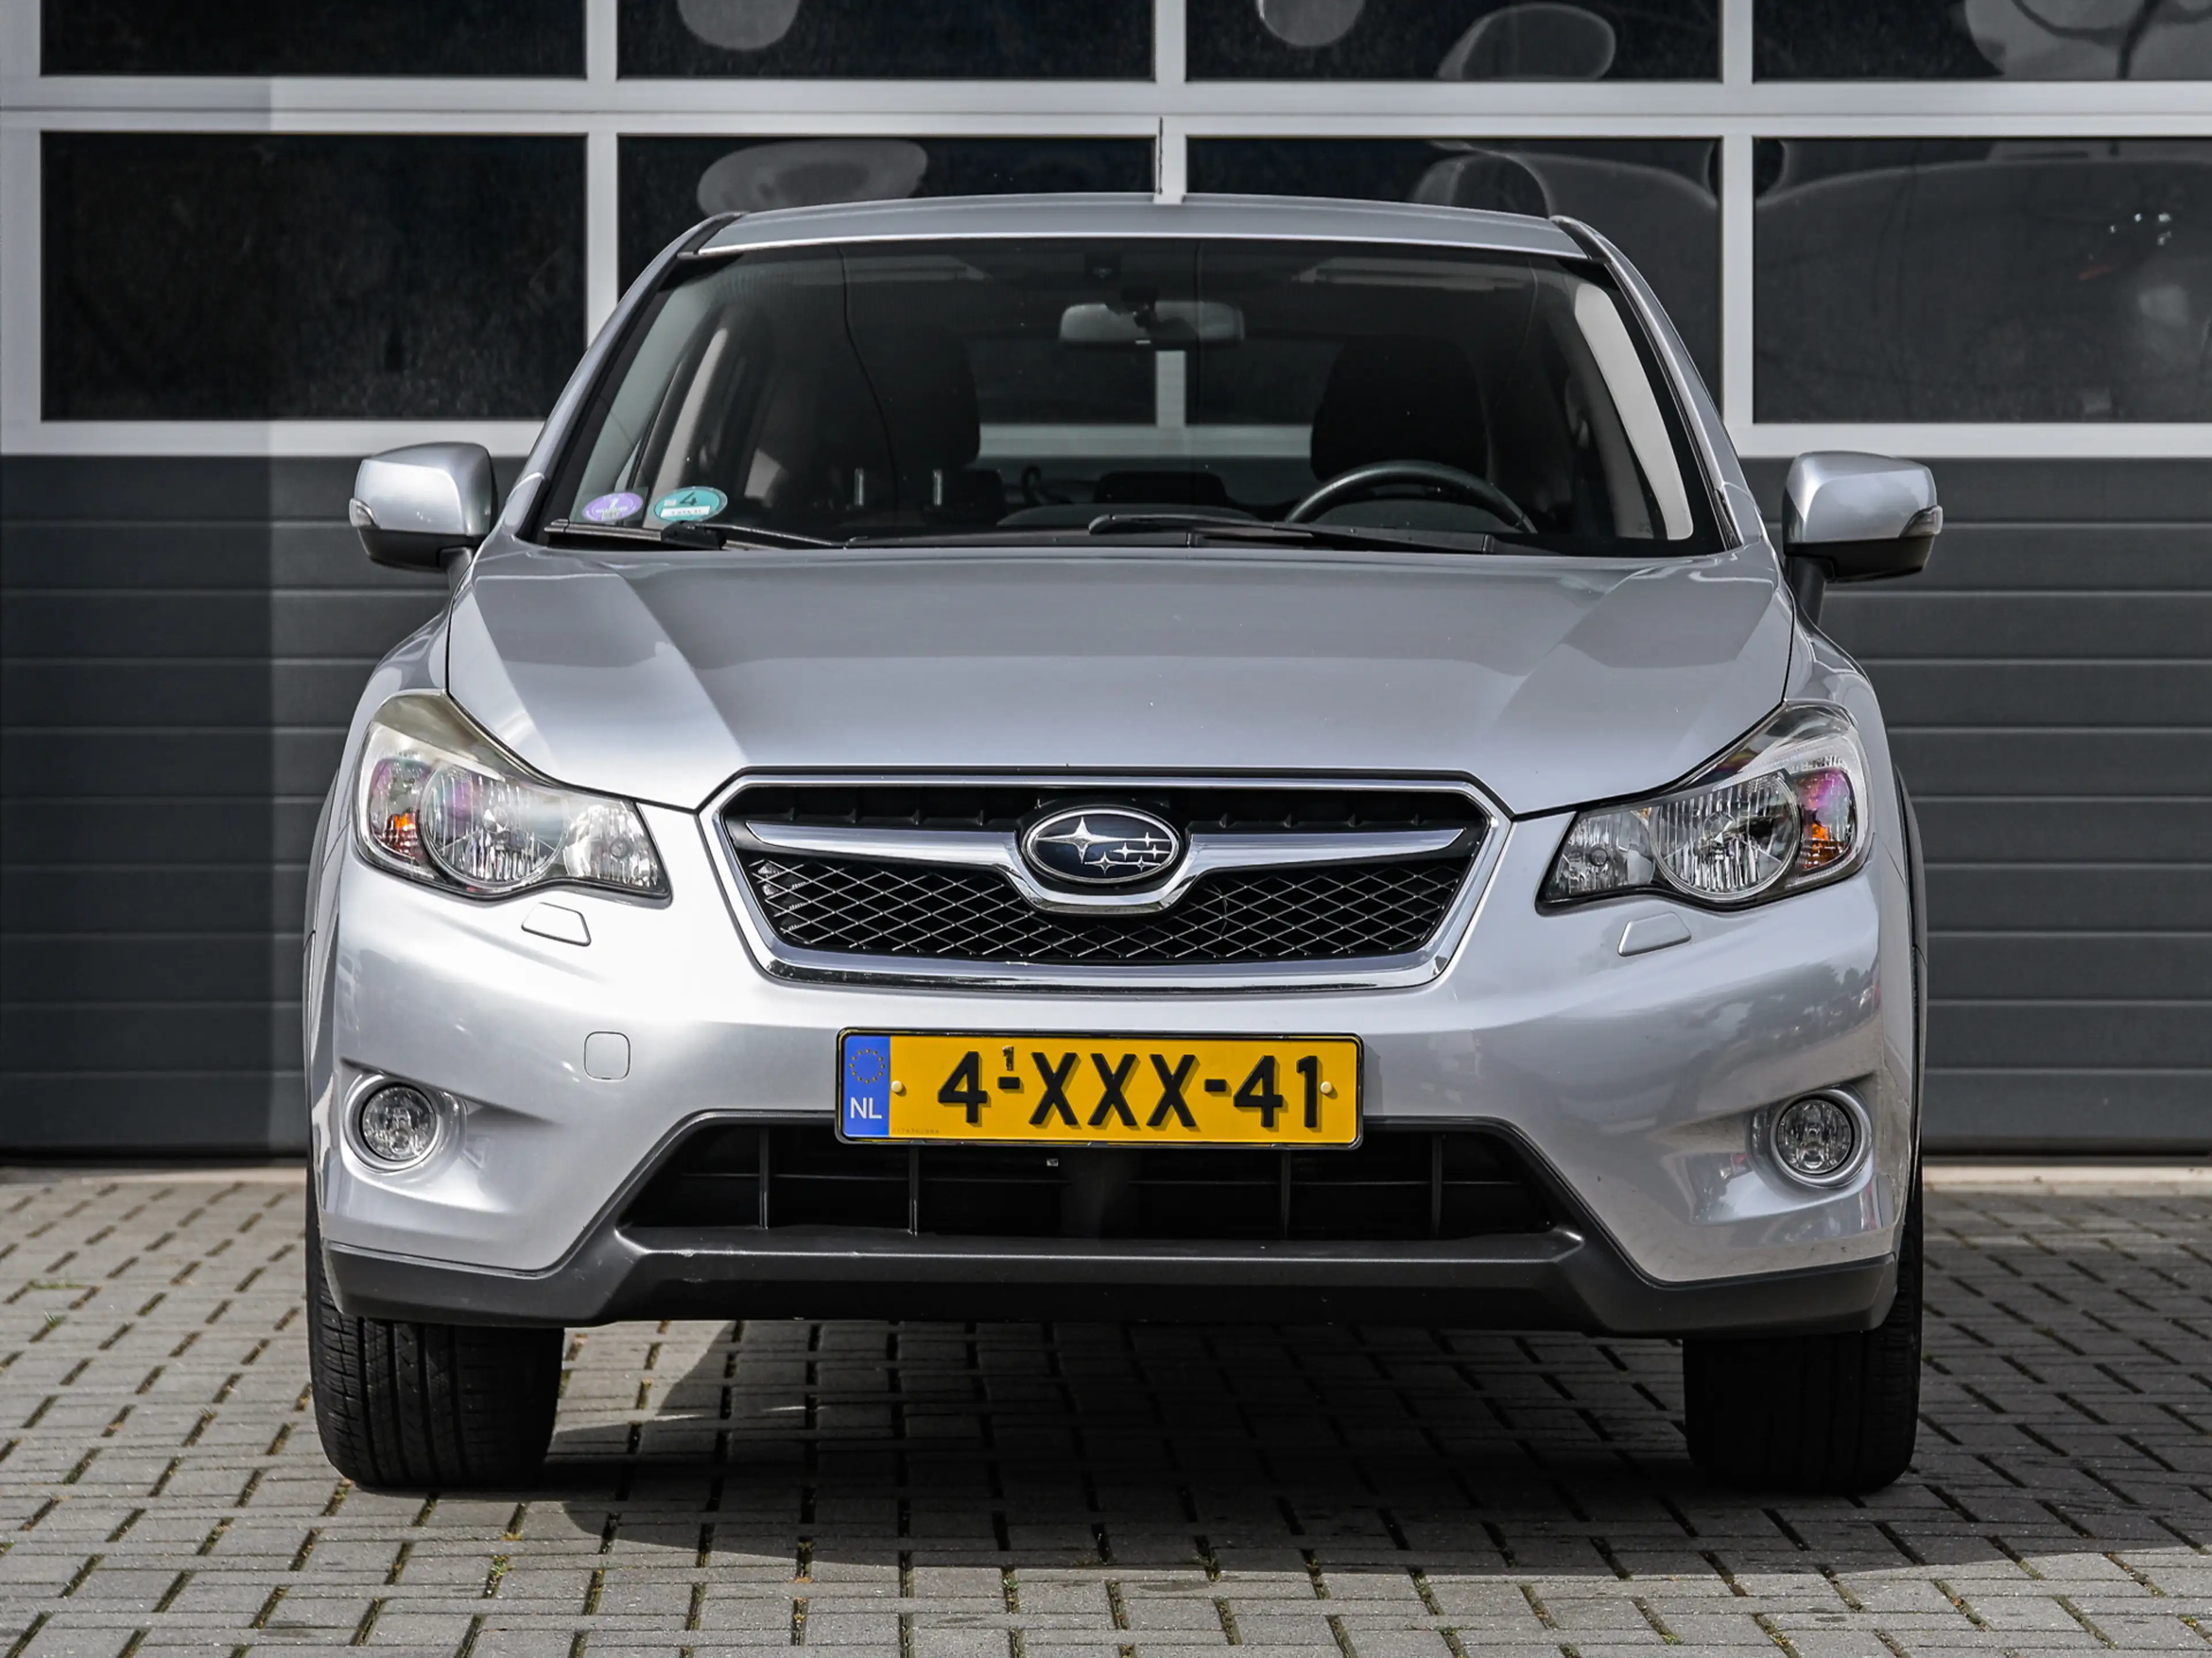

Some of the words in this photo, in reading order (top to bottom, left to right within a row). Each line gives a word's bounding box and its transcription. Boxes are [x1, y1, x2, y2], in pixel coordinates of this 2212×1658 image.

[679, 491, 698, 506] 4
[1002, 1045, 1014, 1072] 1
[937, 1050, 1319, 1128] 4-XXX-41
[850, 1096, 882, 1119] NL
